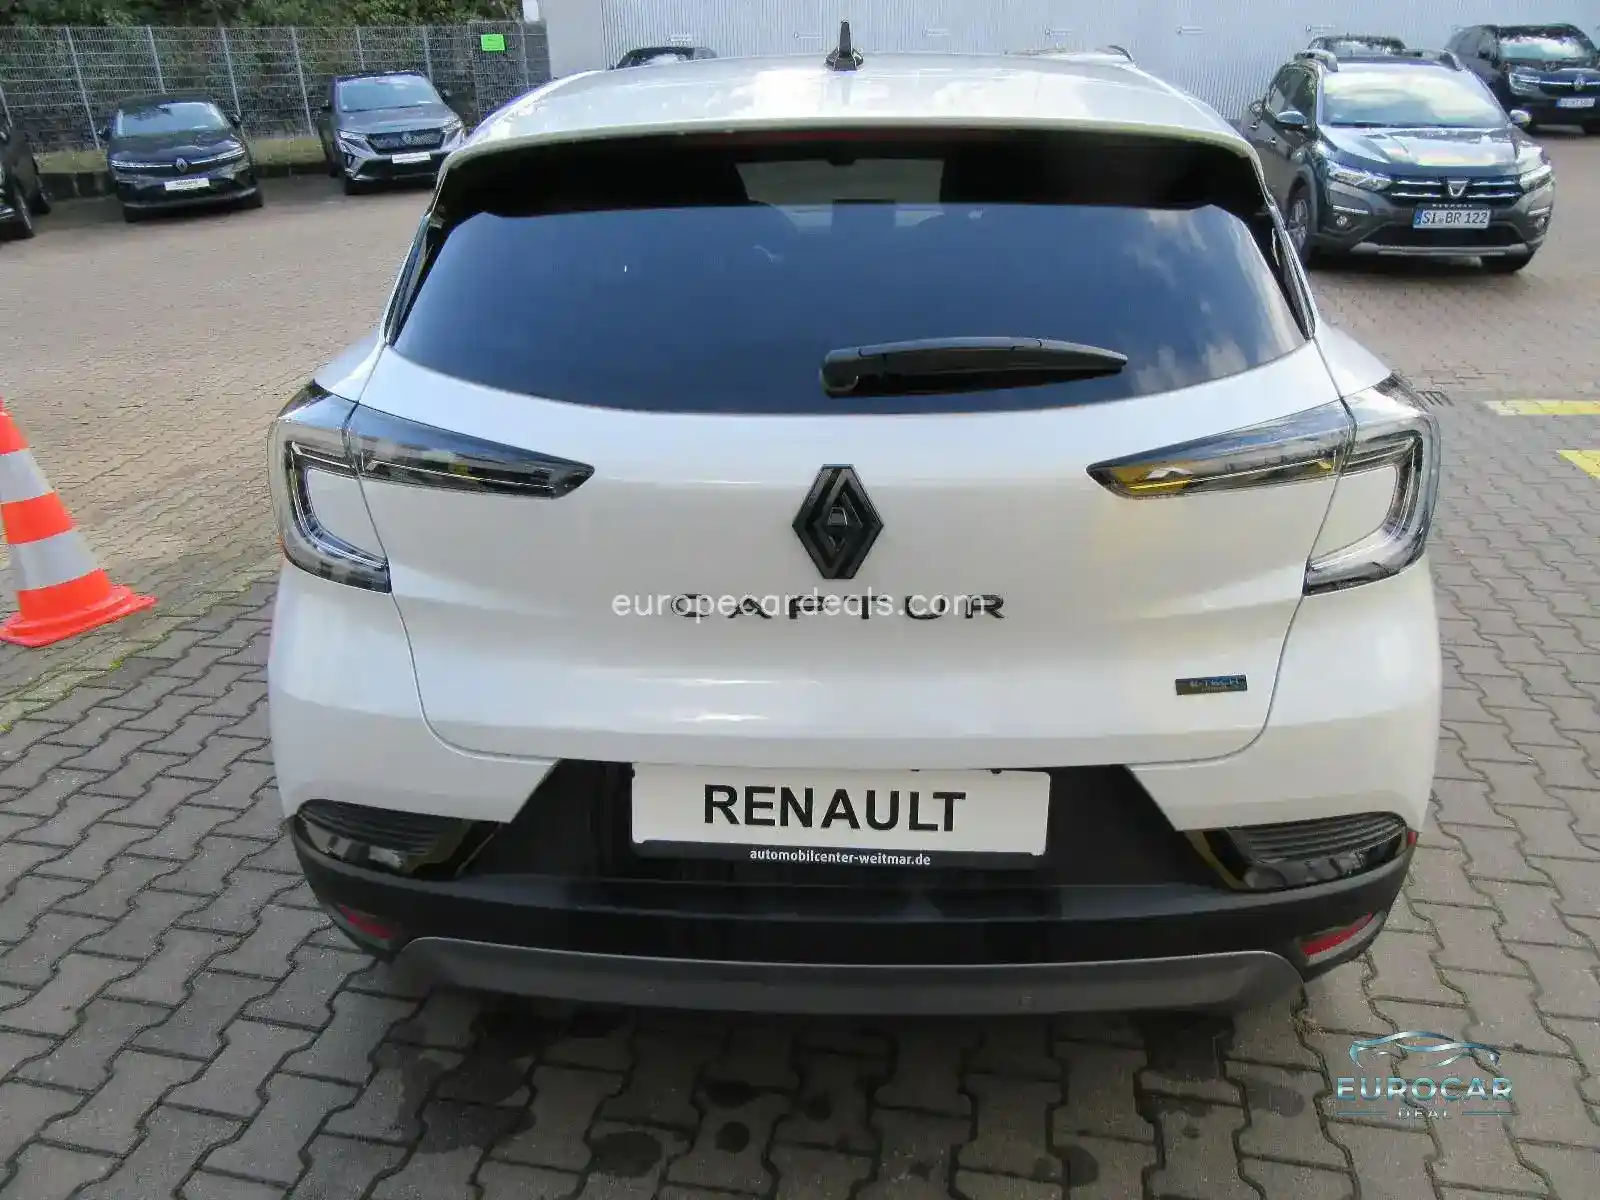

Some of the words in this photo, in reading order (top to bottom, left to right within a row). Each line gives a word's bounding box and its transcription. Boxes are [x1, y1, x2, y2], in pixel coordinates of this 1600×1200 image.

[1464, 211, 1488, 225] 122
[670, 593, 1005, 620] CAPTUR
[704, 783, 967, 833] RENAULT
[749, 848, 931, 866] automobilcenter-weitmar.de
